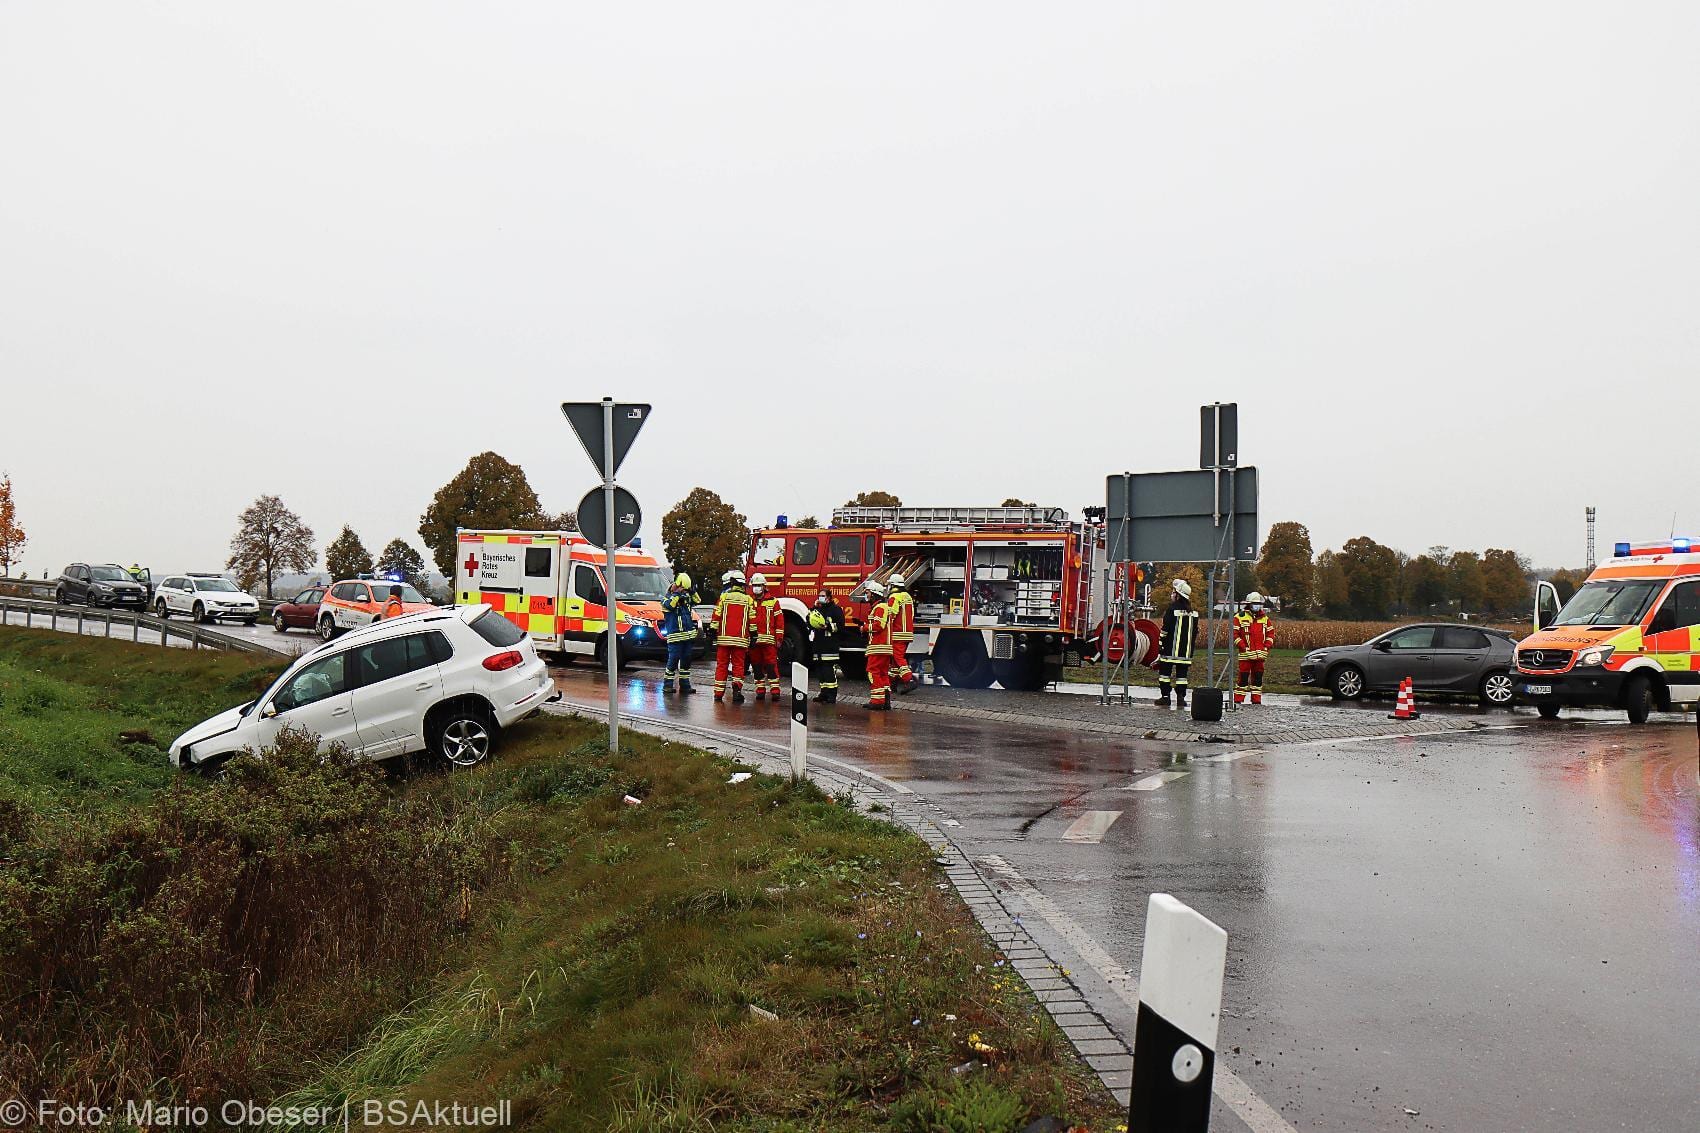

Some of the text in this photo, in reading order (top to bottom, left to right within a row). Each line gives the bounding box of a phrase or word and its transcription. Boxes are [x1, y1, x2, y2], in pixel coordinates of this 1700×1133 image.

[482, 553, 516, 562] Bayerisches
[481, 562, 498, 570] Rotes
[785, 588, 818, 596] FEUERWEHR
